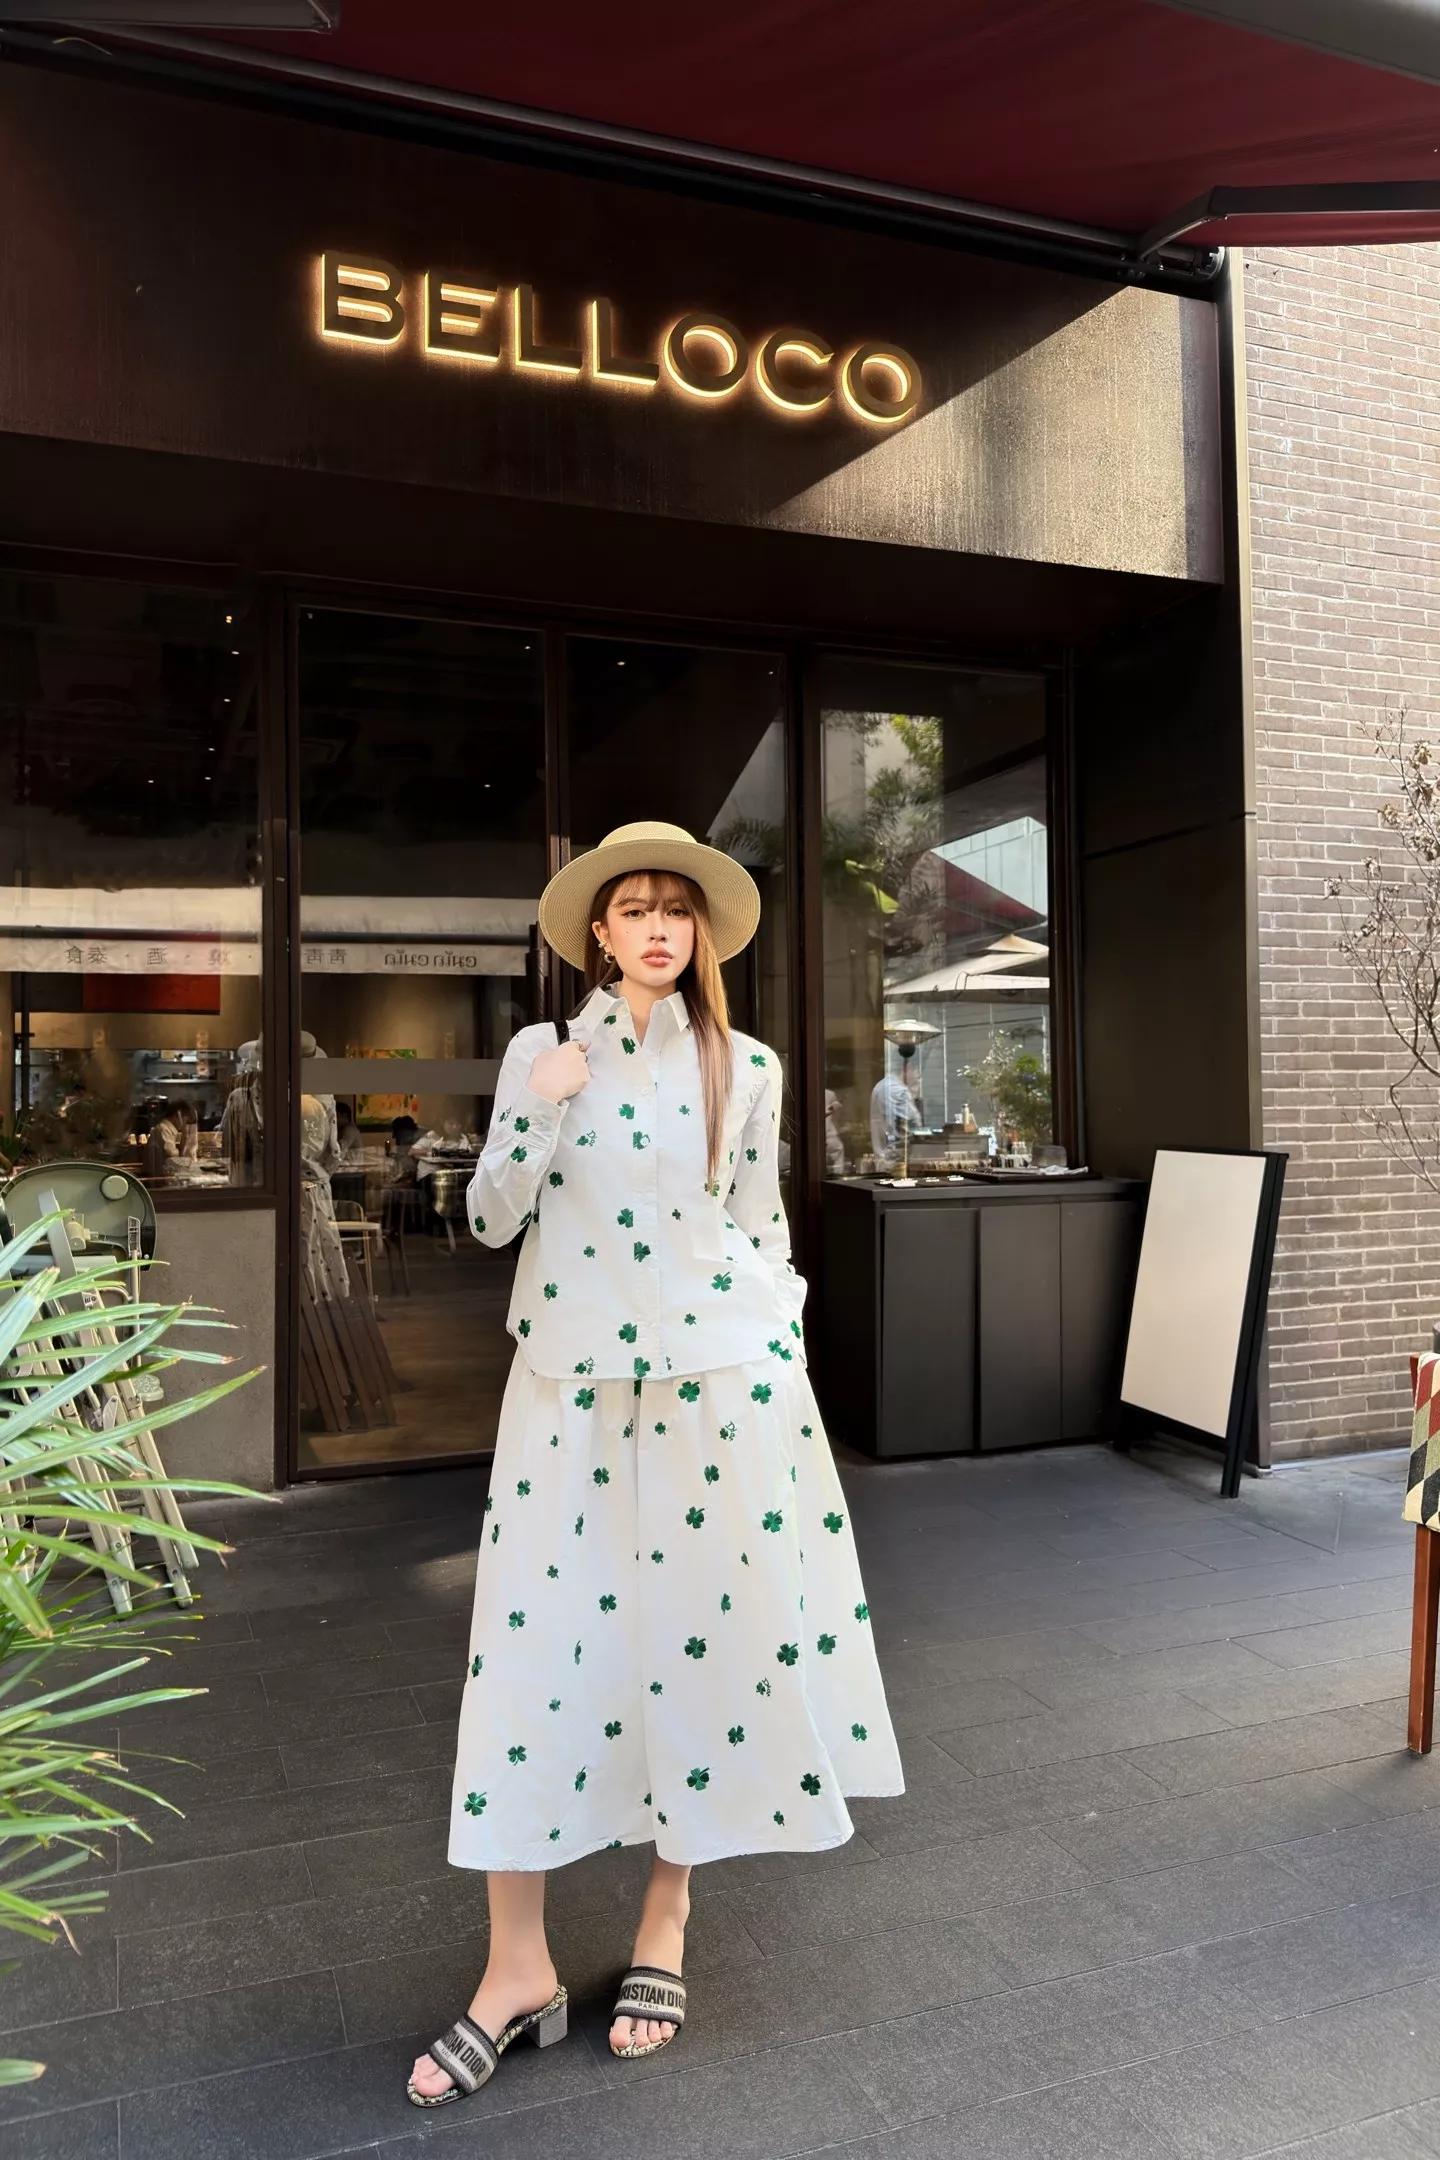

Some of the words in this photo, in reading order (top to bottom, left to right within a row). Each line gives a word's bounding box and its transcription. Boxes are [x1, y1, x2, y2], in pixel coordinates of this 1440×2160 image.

[320, 252, 923, 424] BELLOCO
[620, 1983, 666, 2005] RISTIAN
[667, 1990, 686, 2010] DIO
[459, 2045, 486, 2080] DIOR
